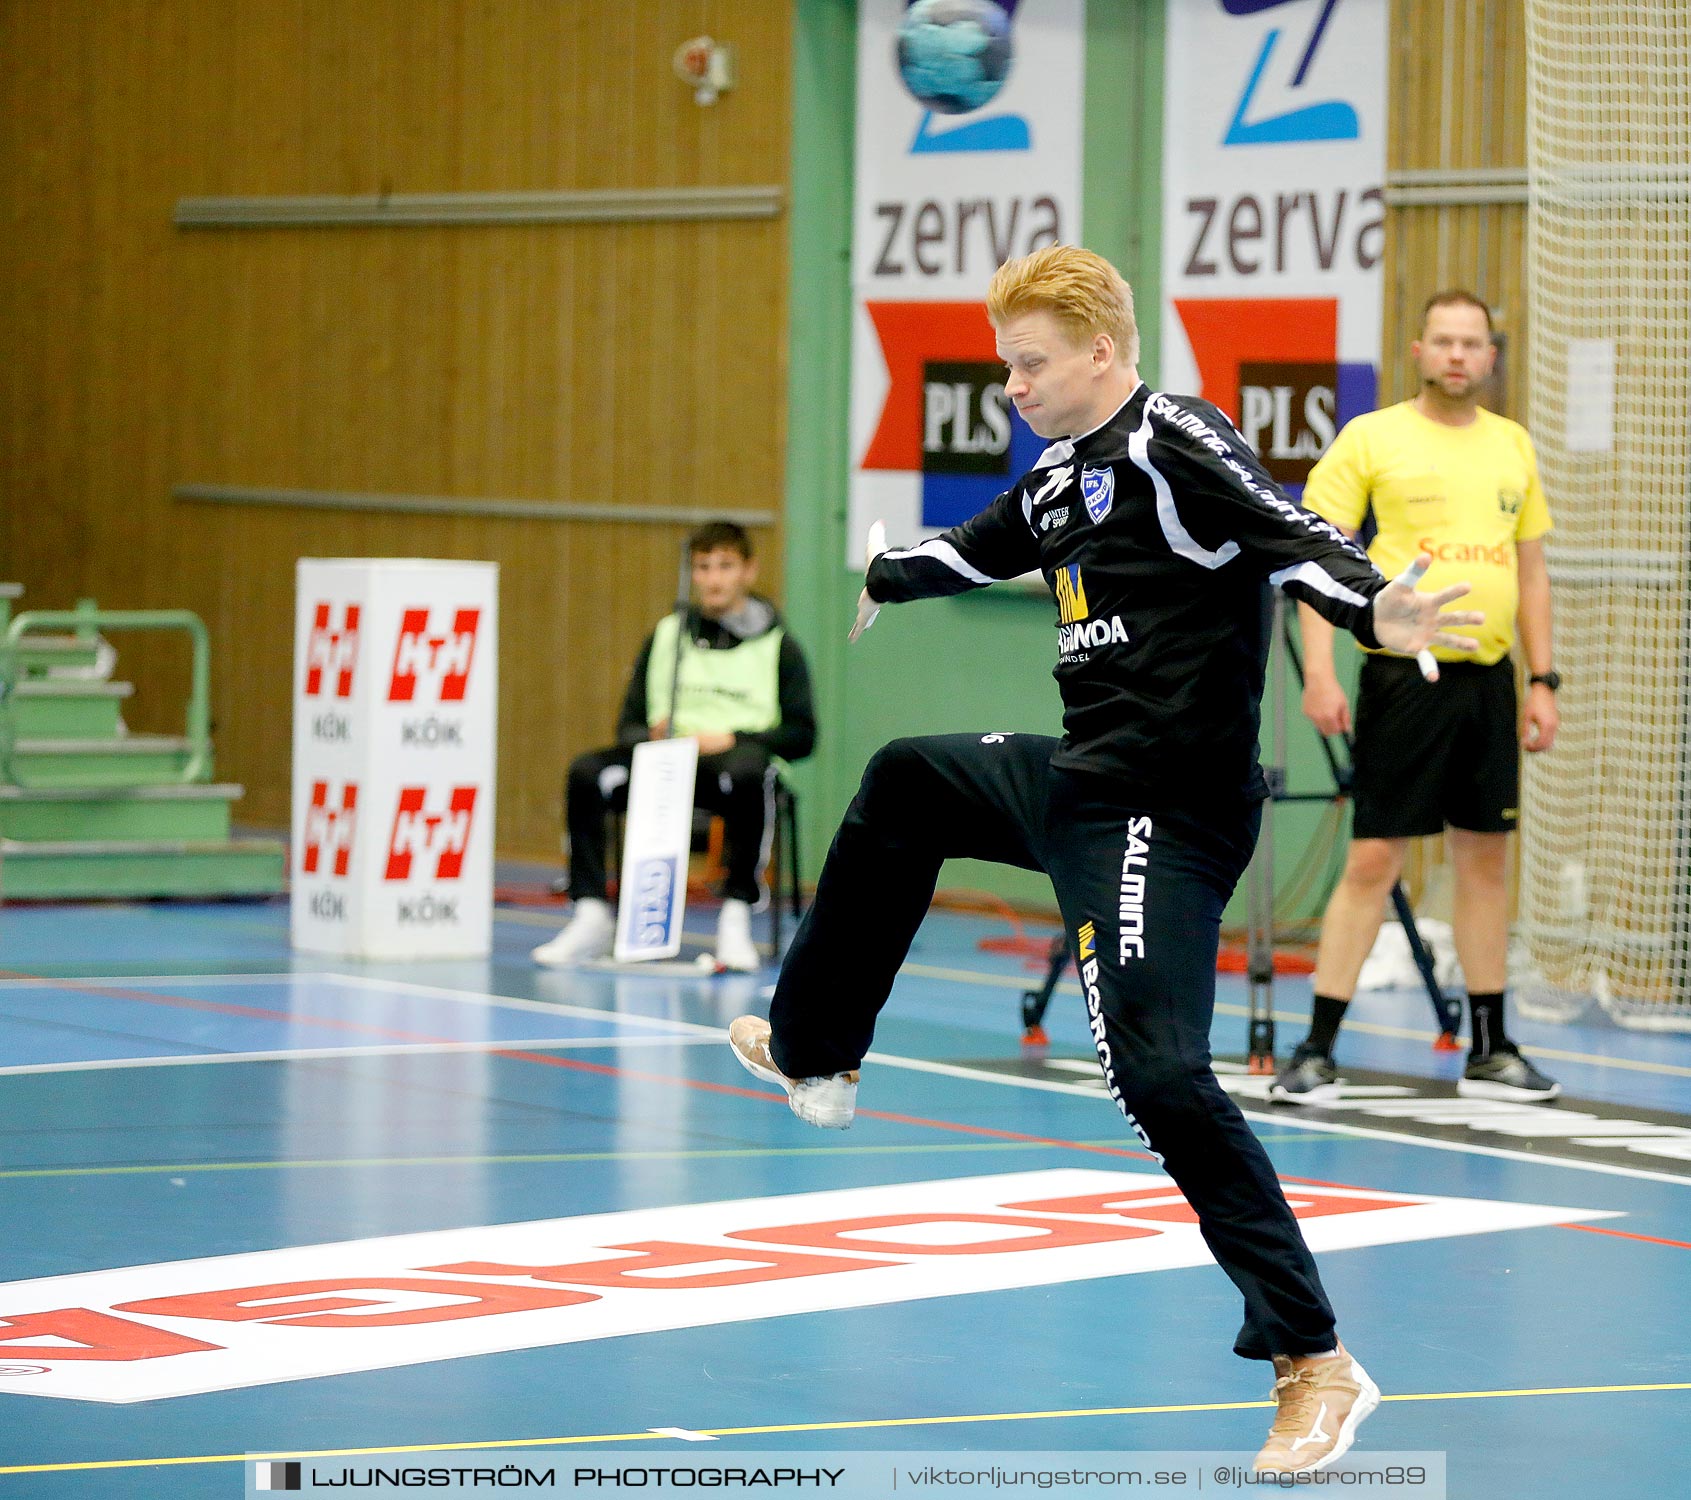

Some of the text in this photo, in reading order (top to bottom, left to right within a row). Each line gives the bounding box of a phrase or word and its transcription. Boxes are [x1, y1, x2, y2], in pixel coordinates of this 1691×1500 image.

[874, 195, 1061, 275] zerva
[1184, 188, 1384, 275] zerva
[924, 383, 1011, 455] PLS
[1240, 385, 1337, 461] PLS
[1049, 506, 1069, 519] INTER
[1052, 515, 1068, 529] SPORT
